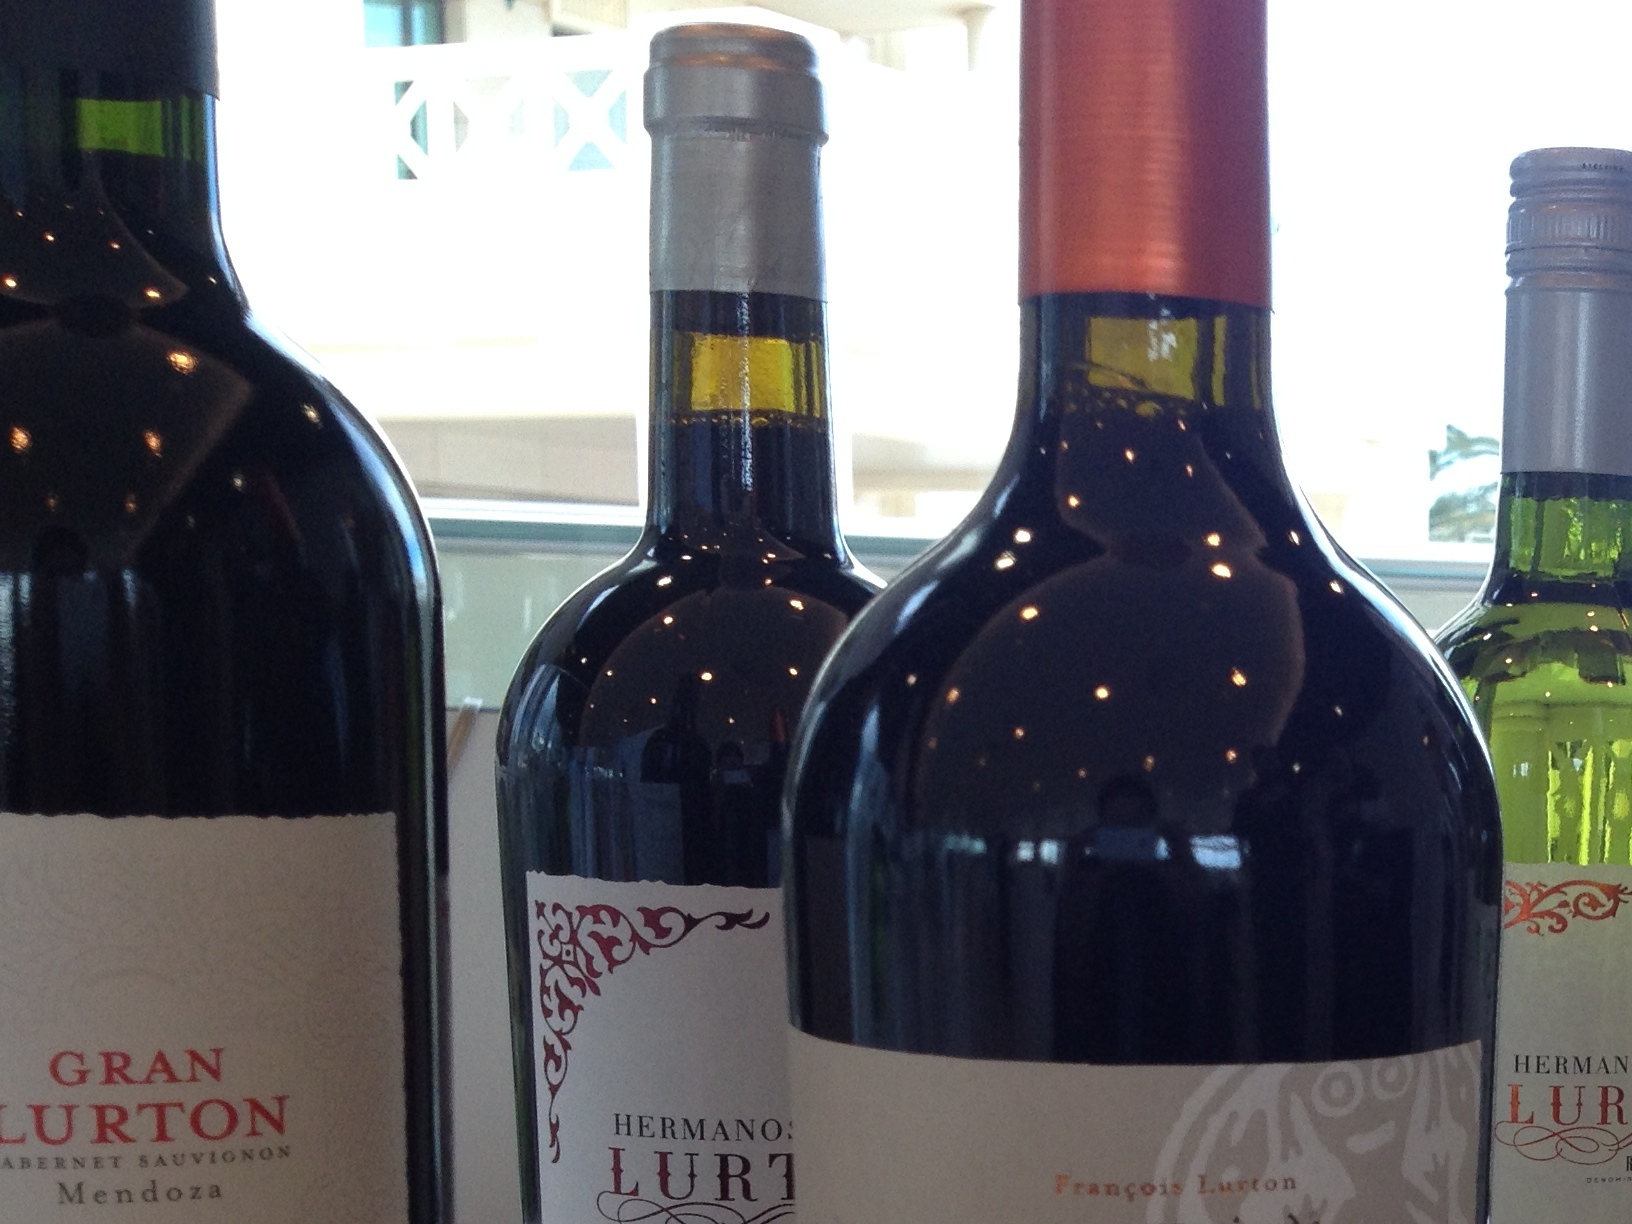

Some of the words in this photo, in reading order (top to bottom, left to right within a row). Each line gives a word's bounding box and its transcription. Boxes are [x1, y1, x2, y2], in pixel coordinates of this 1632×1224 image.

[49, 1047, 225, 1087] GRAN
[0, 1095, 290, 1146] LURTON
[138, 1145, 291, 1168] SAUVIGNON
[57, 1179, 223, 1205] Mendoza
[1055, 1173, 1183, 1202] François
[1197, 1174, 1296, 1195] Lurton
